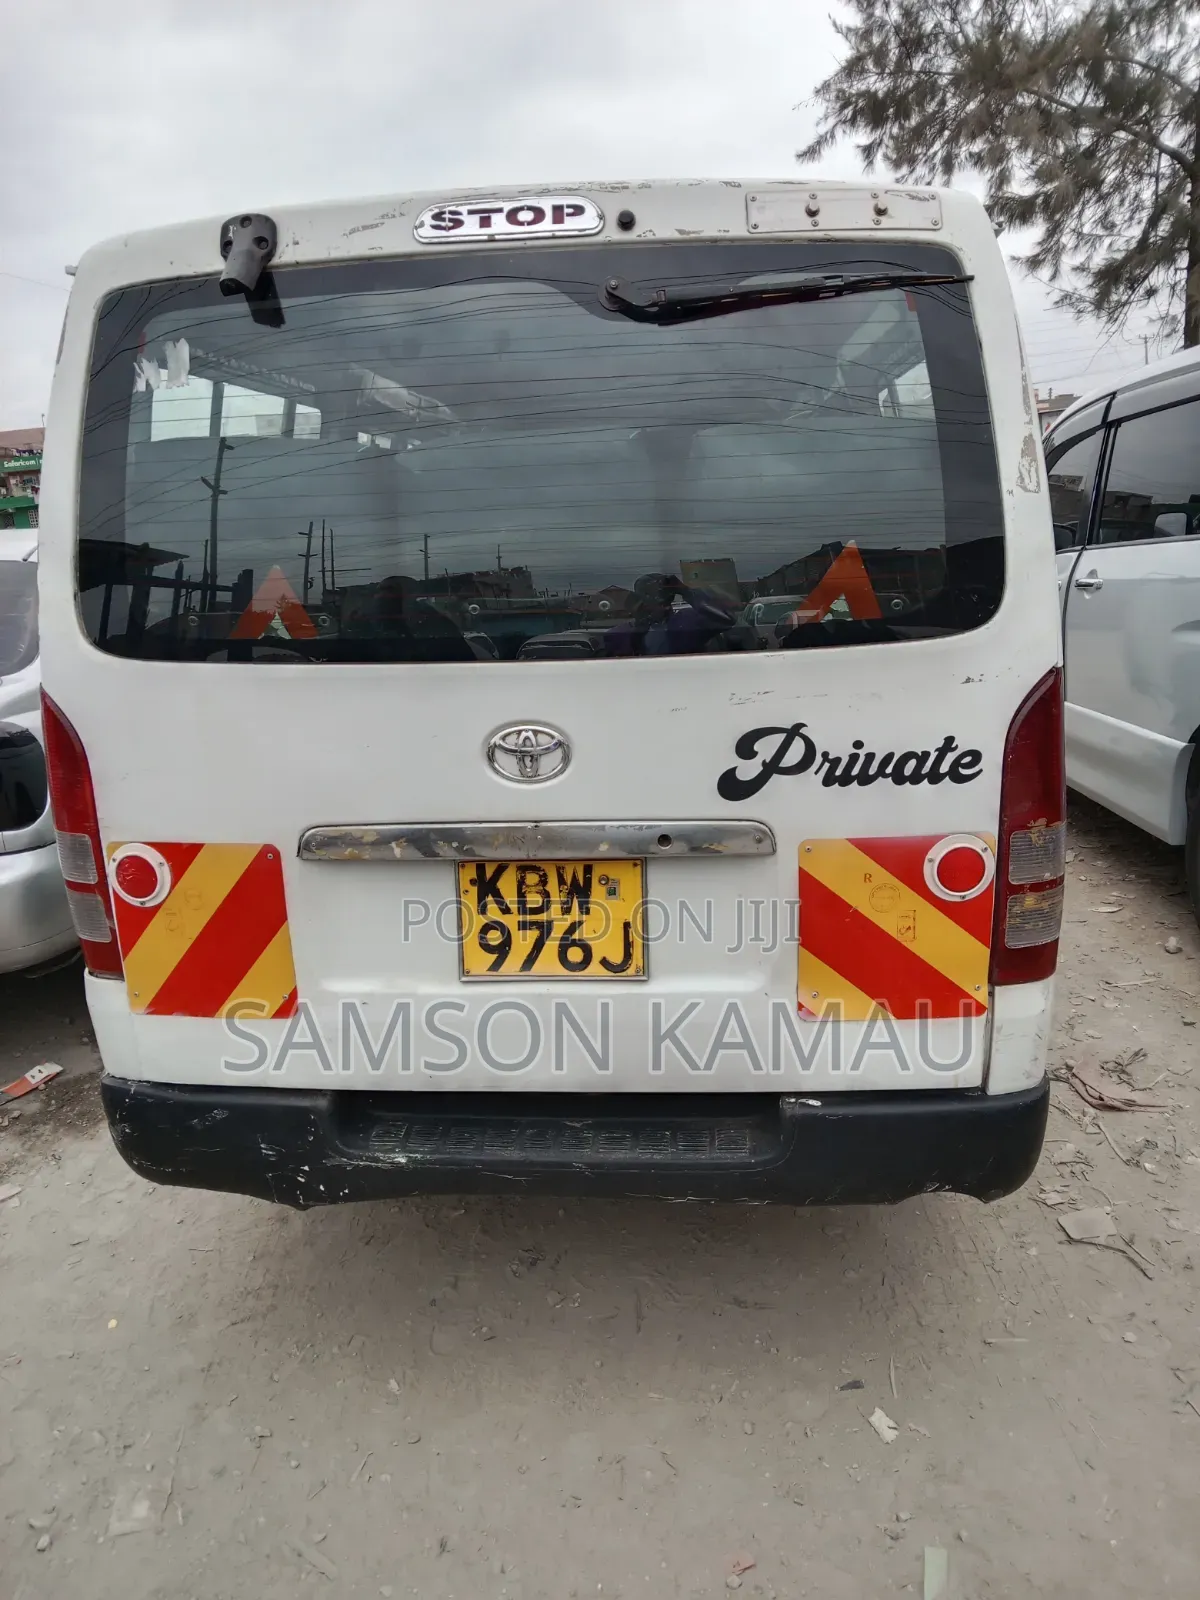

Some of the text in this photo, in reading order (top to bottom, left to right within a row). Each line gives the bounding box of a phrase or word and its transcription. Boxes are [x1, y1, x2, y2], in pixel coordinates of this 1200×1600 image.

[430, 204, 585, 231] STOP
[717, 722, 983, 801] Private
[476, 864, 593, 915] KBW
[478, 920, 633, 973] 976J
